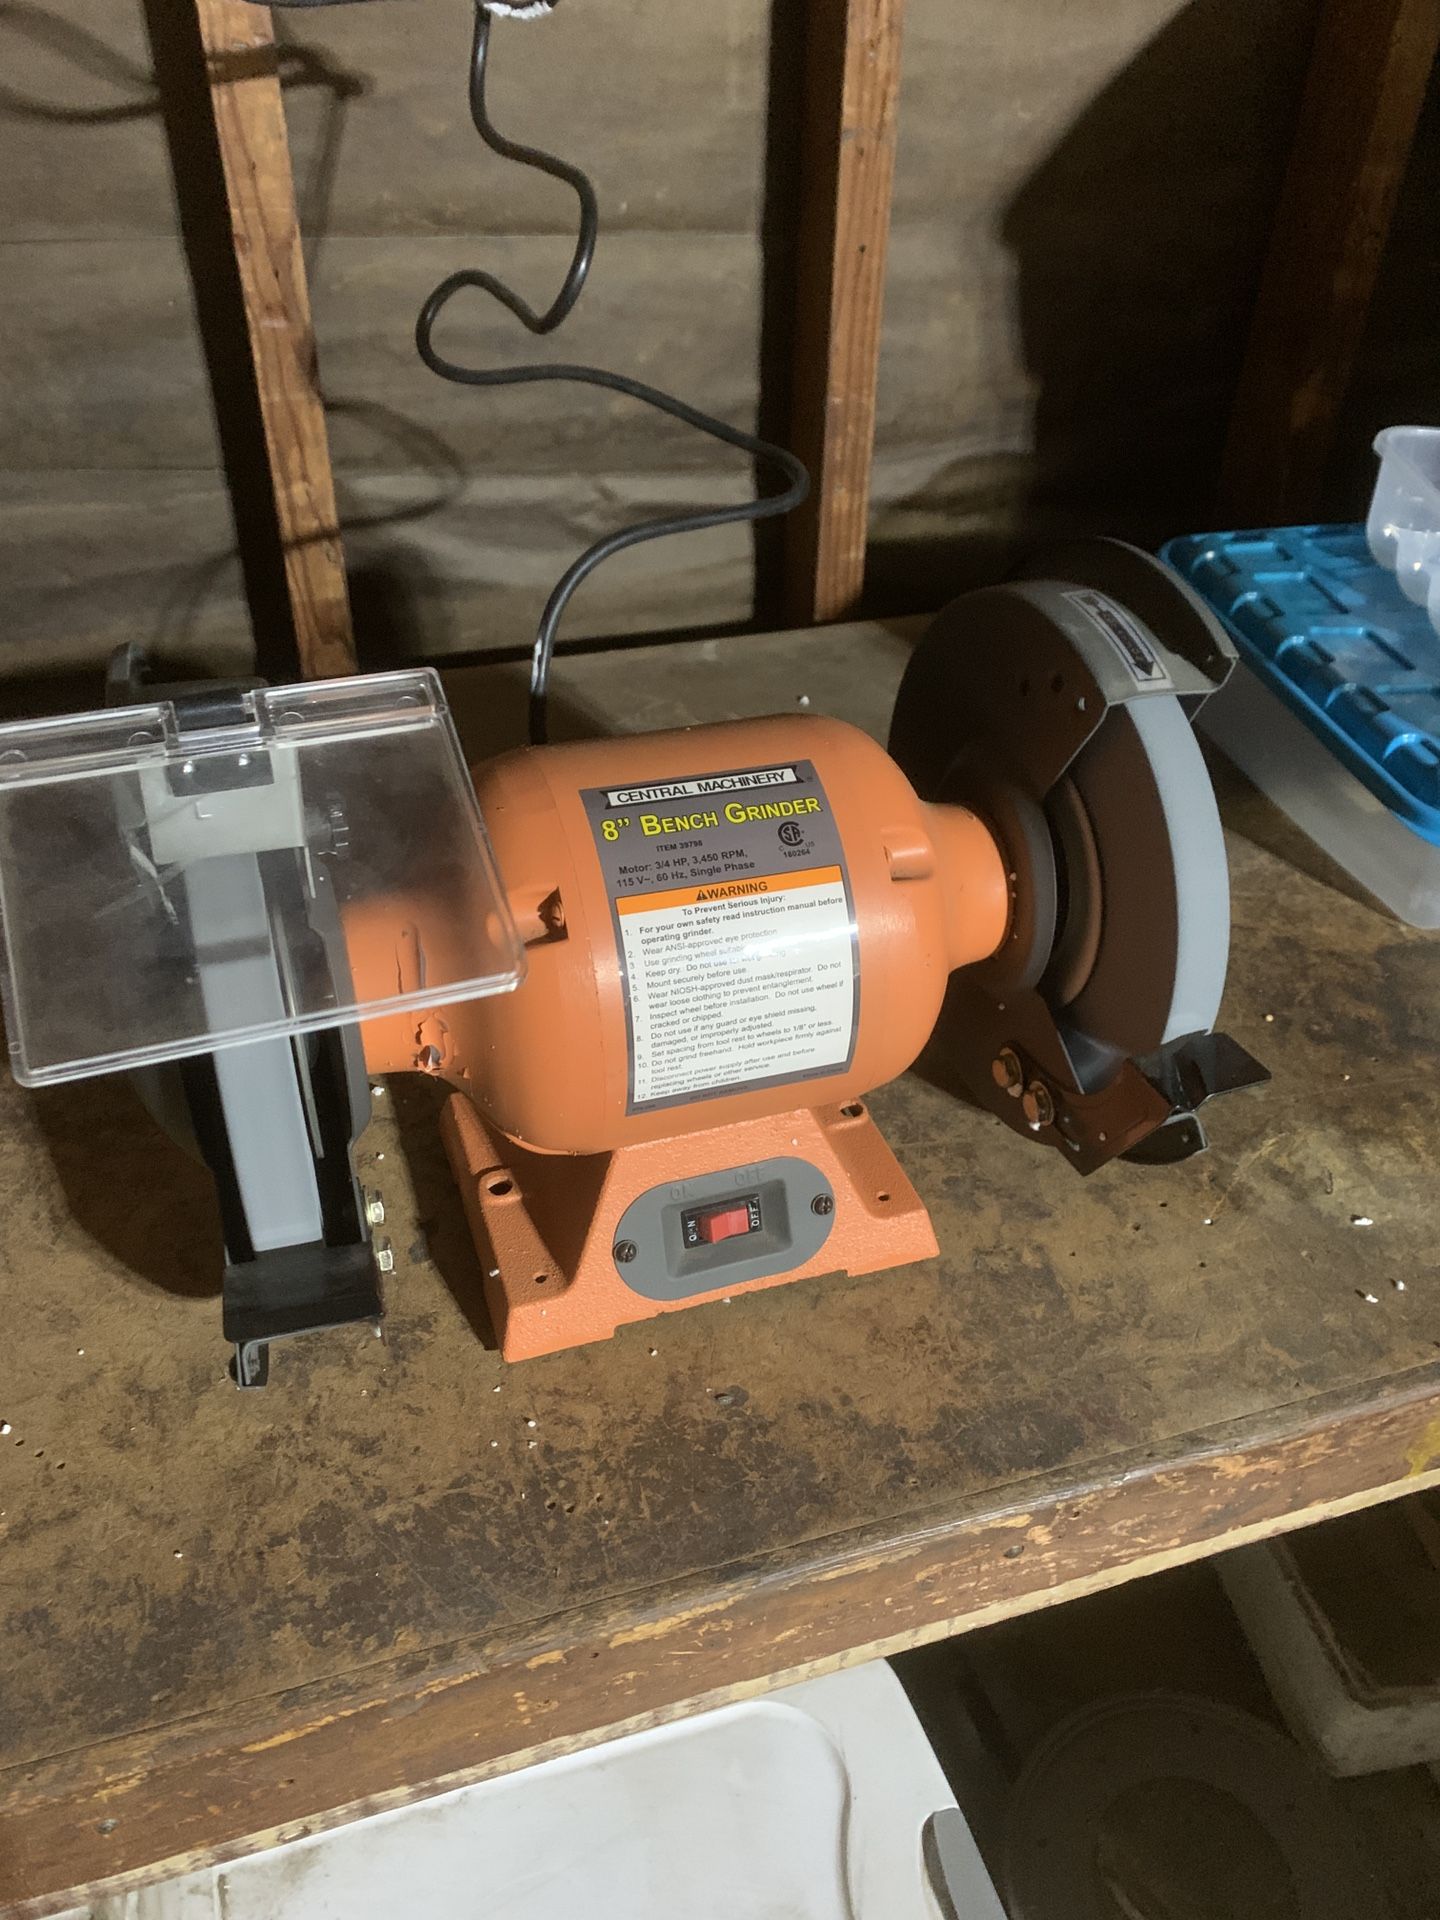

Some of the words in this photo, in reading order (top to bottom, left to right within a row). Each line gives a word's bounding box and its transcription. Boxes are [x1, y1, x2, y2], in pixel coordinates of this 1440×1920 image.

[617, 785, 693, 803] CENTRAL
[699, 771, 785, 792] MACHINERY
[656, 843, 677, 852] ITEM
[619, 864, 652, 875] Motor:
[655, 859, 670, 869] 3/4
[673, 857, 690, 867] HP,
[692, 853, 718, 865] 3,450
[617, 878, 634, 888] 115
[656, 873, 668, 881] 60
[690, 866, 721, 877] Single
[725, 861, 755, 872] Phase
[708, 881, 768, 899] WARNING
[639, 926, 653, 934] For
[656, 923, 674, 932] your
[696, 915, 720, 925] safety
[723, 912, 740, 920] read
[742, 906, 785, 918] instruction
[787, 901, 816, 911] manual
[818, 897, 842, 906] before
[695, 903, 725, 914] Prevent
[728, 899, 758, 909] Serious
[641, 934, 680, 945] operating
[642, 948, 663, 956] Wear
[665, 939, 723, 951] ANSI-approved
[725, 936, 738, 944] eye
[644, 959, 660, 967] Use
[662, 953, 692, 965] grinding
[646, 968, 666, 978] Keep
[647, 979, 671, 988] Mount
[673, 974, 704, 985] securely
[707, 970, 730, 979] before
[648, 991, 668, 999] Wear
[671, 980, 735, 995] NIOSH-approved
[737, 977, 753, 985] dust
[817, 963, 828, 971] Do
[650, 1010, 677, 1020] Inspect
[680, 1005, 701, 1014] wheel
[704, 1001, 727, 1009] before
[788, 988, 799, 996] not
[816, 982, 837, 991] wheel
[670, 998, 690, 1006] loose
[692, 992, 721, 1003] clothing
[733, 986, 760, 997] prevent
[650, 1019, 679, 1029] cracked
[701, 1023, 713, 1031] any
[716, 1018, 737, 1028] guard
[749, 1014, 762, 1022] eye
[765, 1011, 785, 1019] shield
[701, 1027, 738, 1038] improperly
[667, 1045, 695, 1056] spacing
[757, 1030, 781, 1038] wheels
[738, 1042, 755, 1050] Hold
[757, 1036, 793, 1046] workpiece
[749, 1202, 759, 1227] OFF
[688, 1220, 697, 1241] ON
